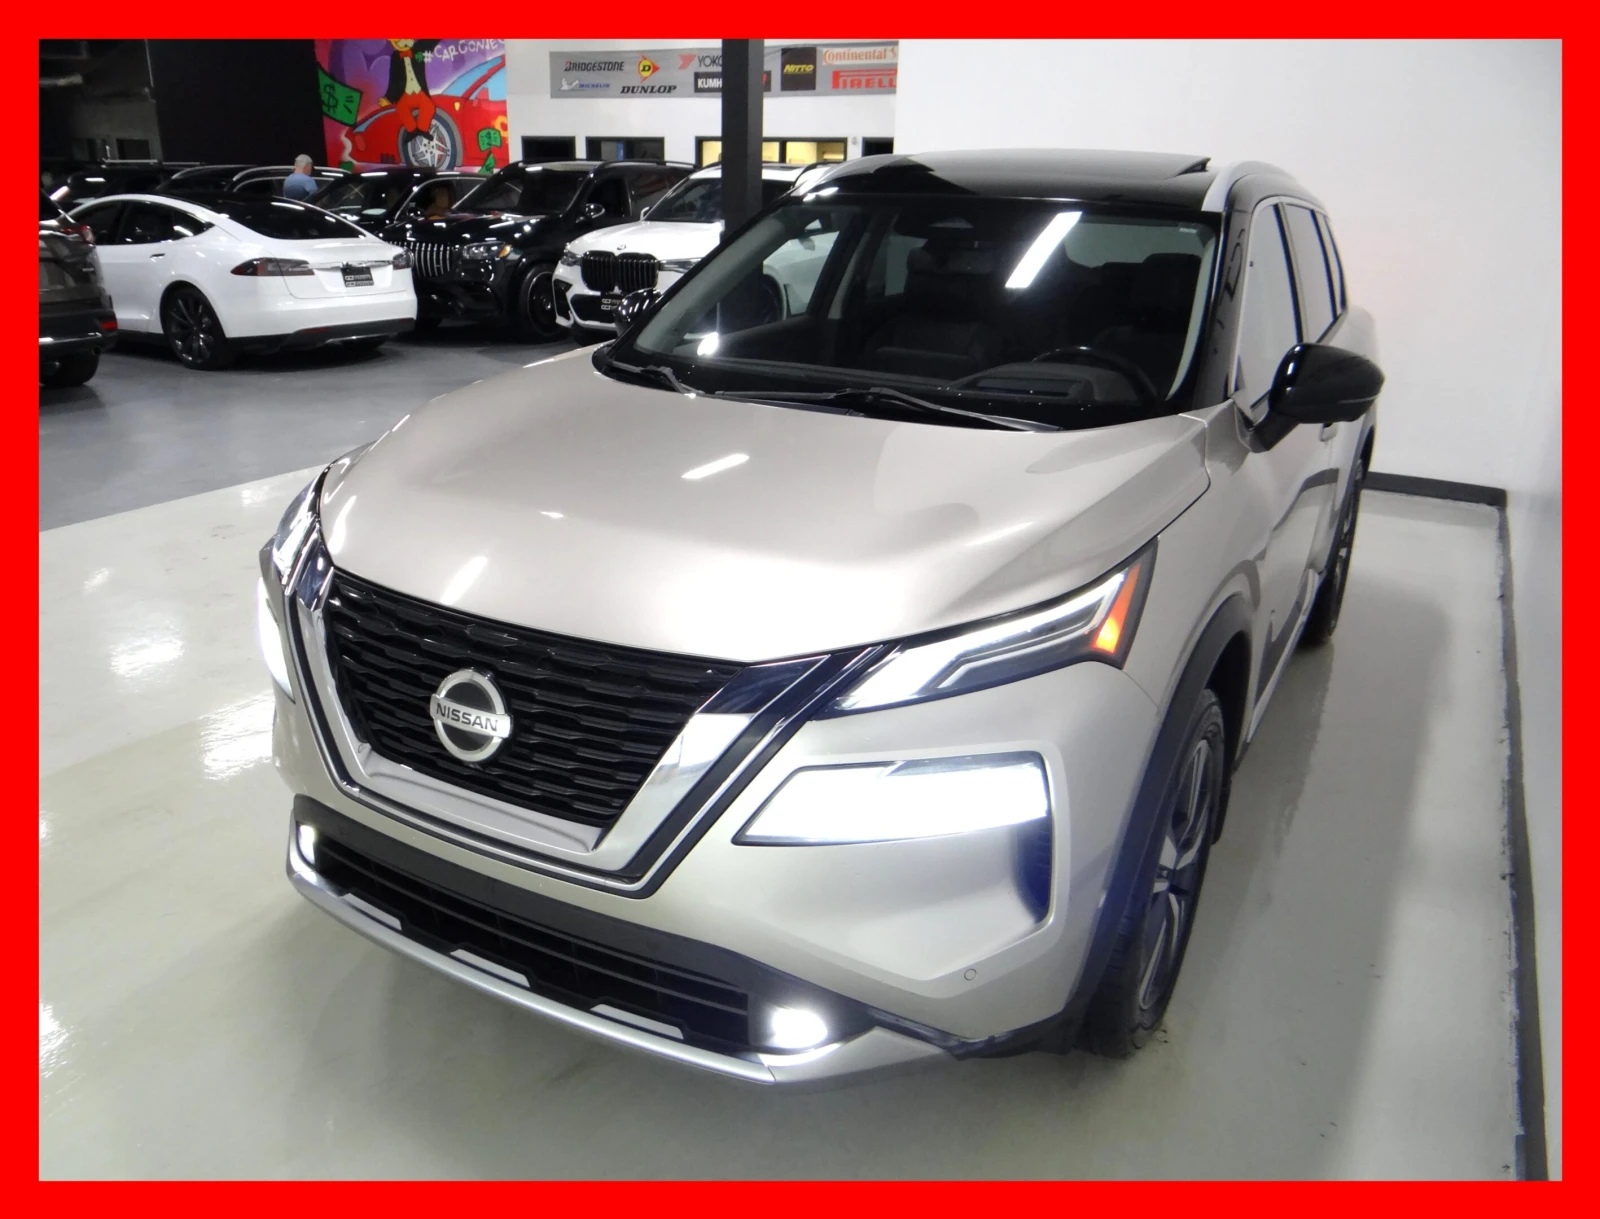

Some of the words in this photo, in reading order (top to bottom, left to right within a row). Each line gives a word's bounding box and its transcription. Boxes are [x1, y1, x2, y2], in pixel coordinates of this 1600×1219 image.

[823, 48, 887, 64] Continental
[564, 61, 625, 72] BRIDGESTONE
[783, 64, 814, 73] NITTO
[620, 85, 677, 94] DUNLOP
[436, 702, 499, 732] NISSAN
